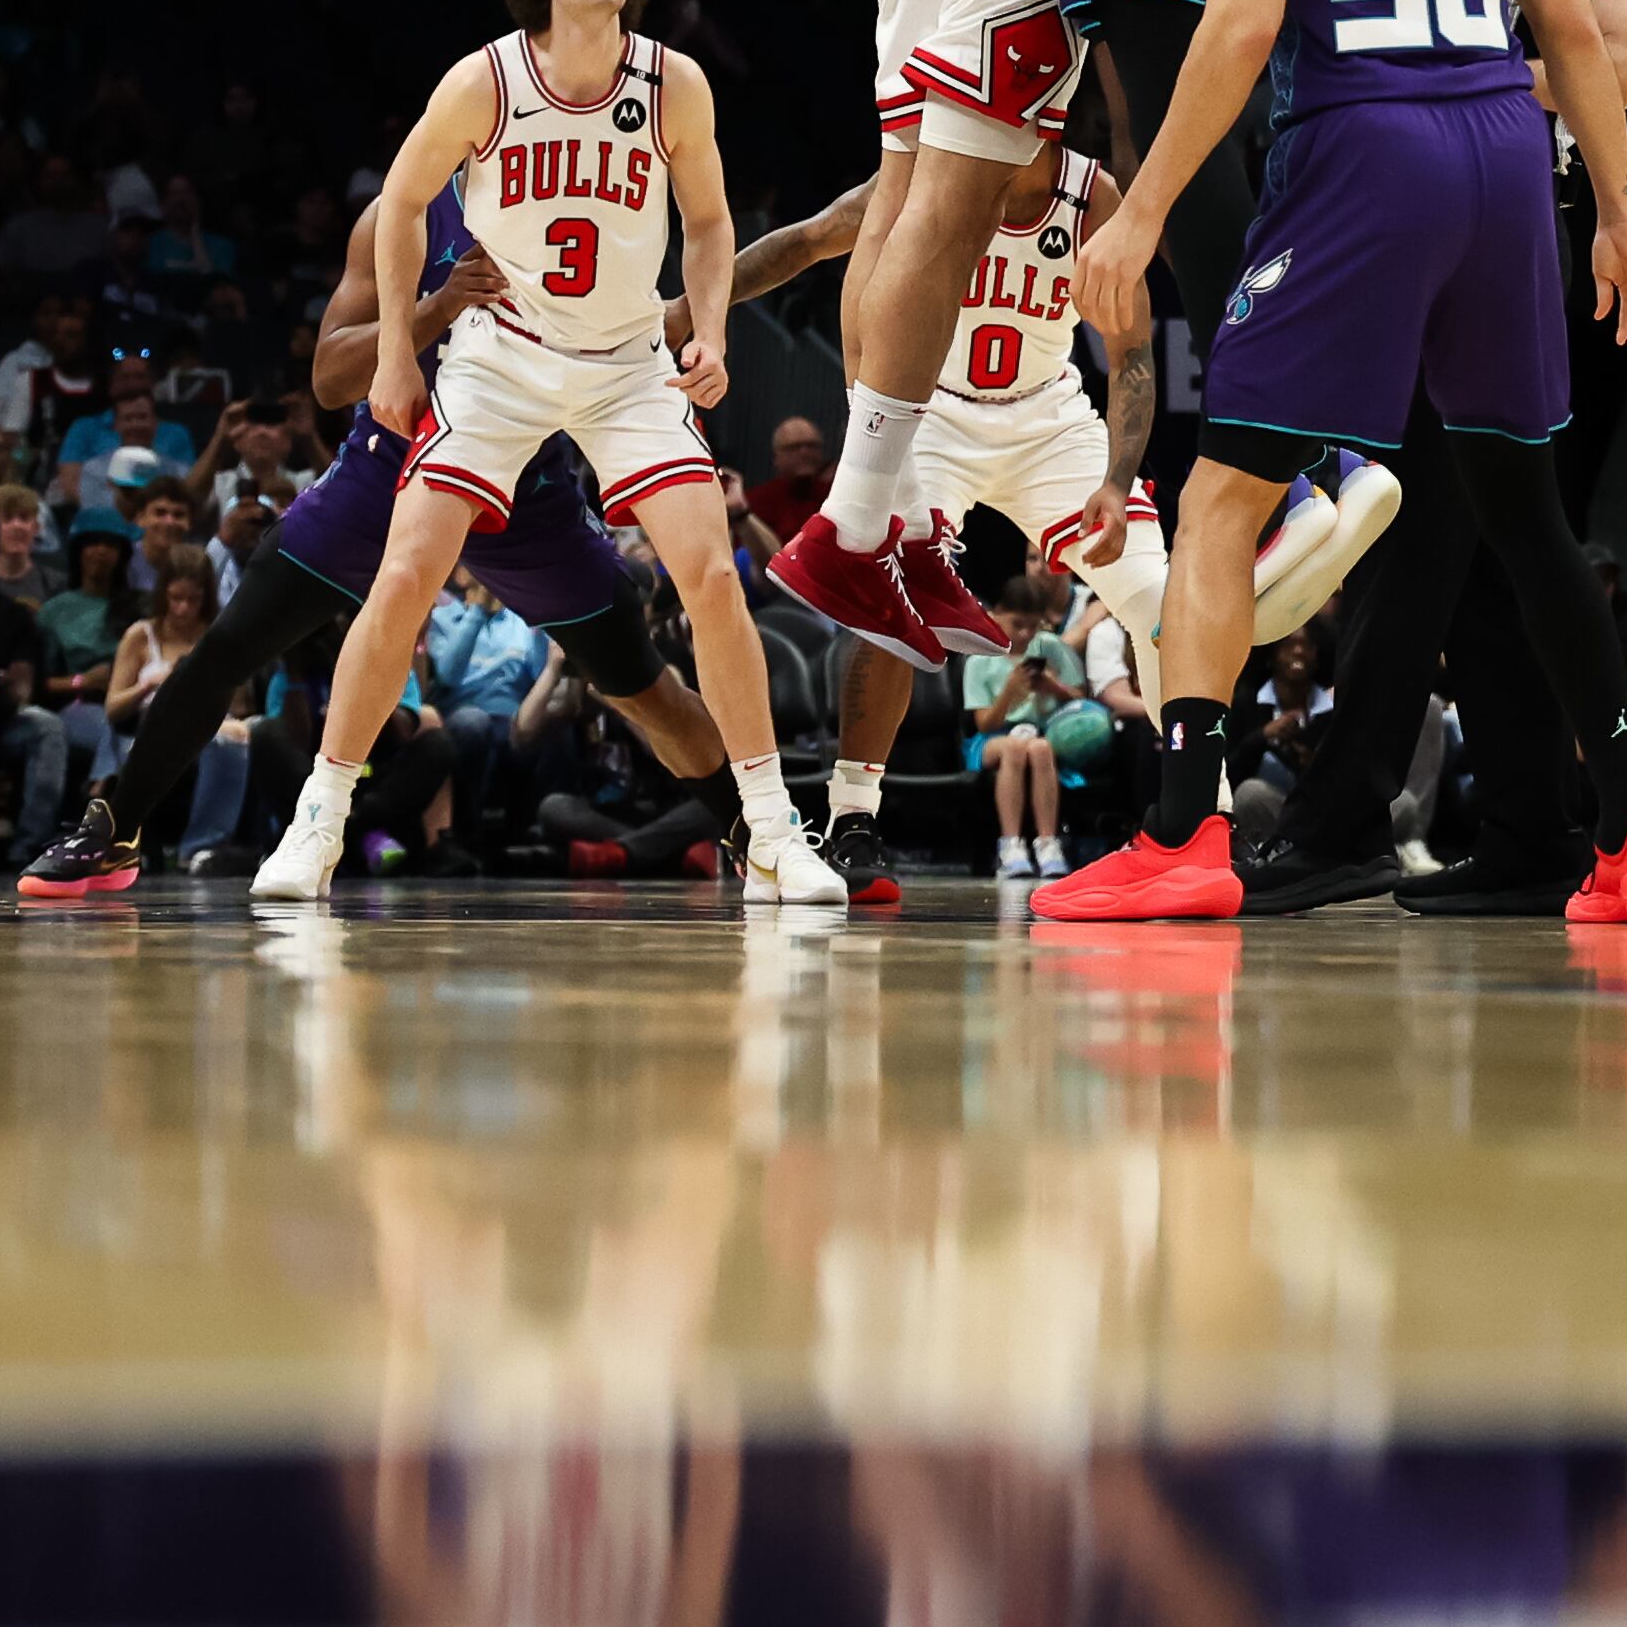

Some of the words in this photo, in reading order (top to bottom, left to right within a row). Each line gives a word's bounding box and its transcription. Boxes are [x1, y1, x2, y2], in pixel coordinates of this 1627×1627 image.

[499, 138, 653, 213] BULLS
[542, 217, 600, 297] 3
[960, 255, 1072, 321] ULLS
[966, 323, 1024, 390] 0
